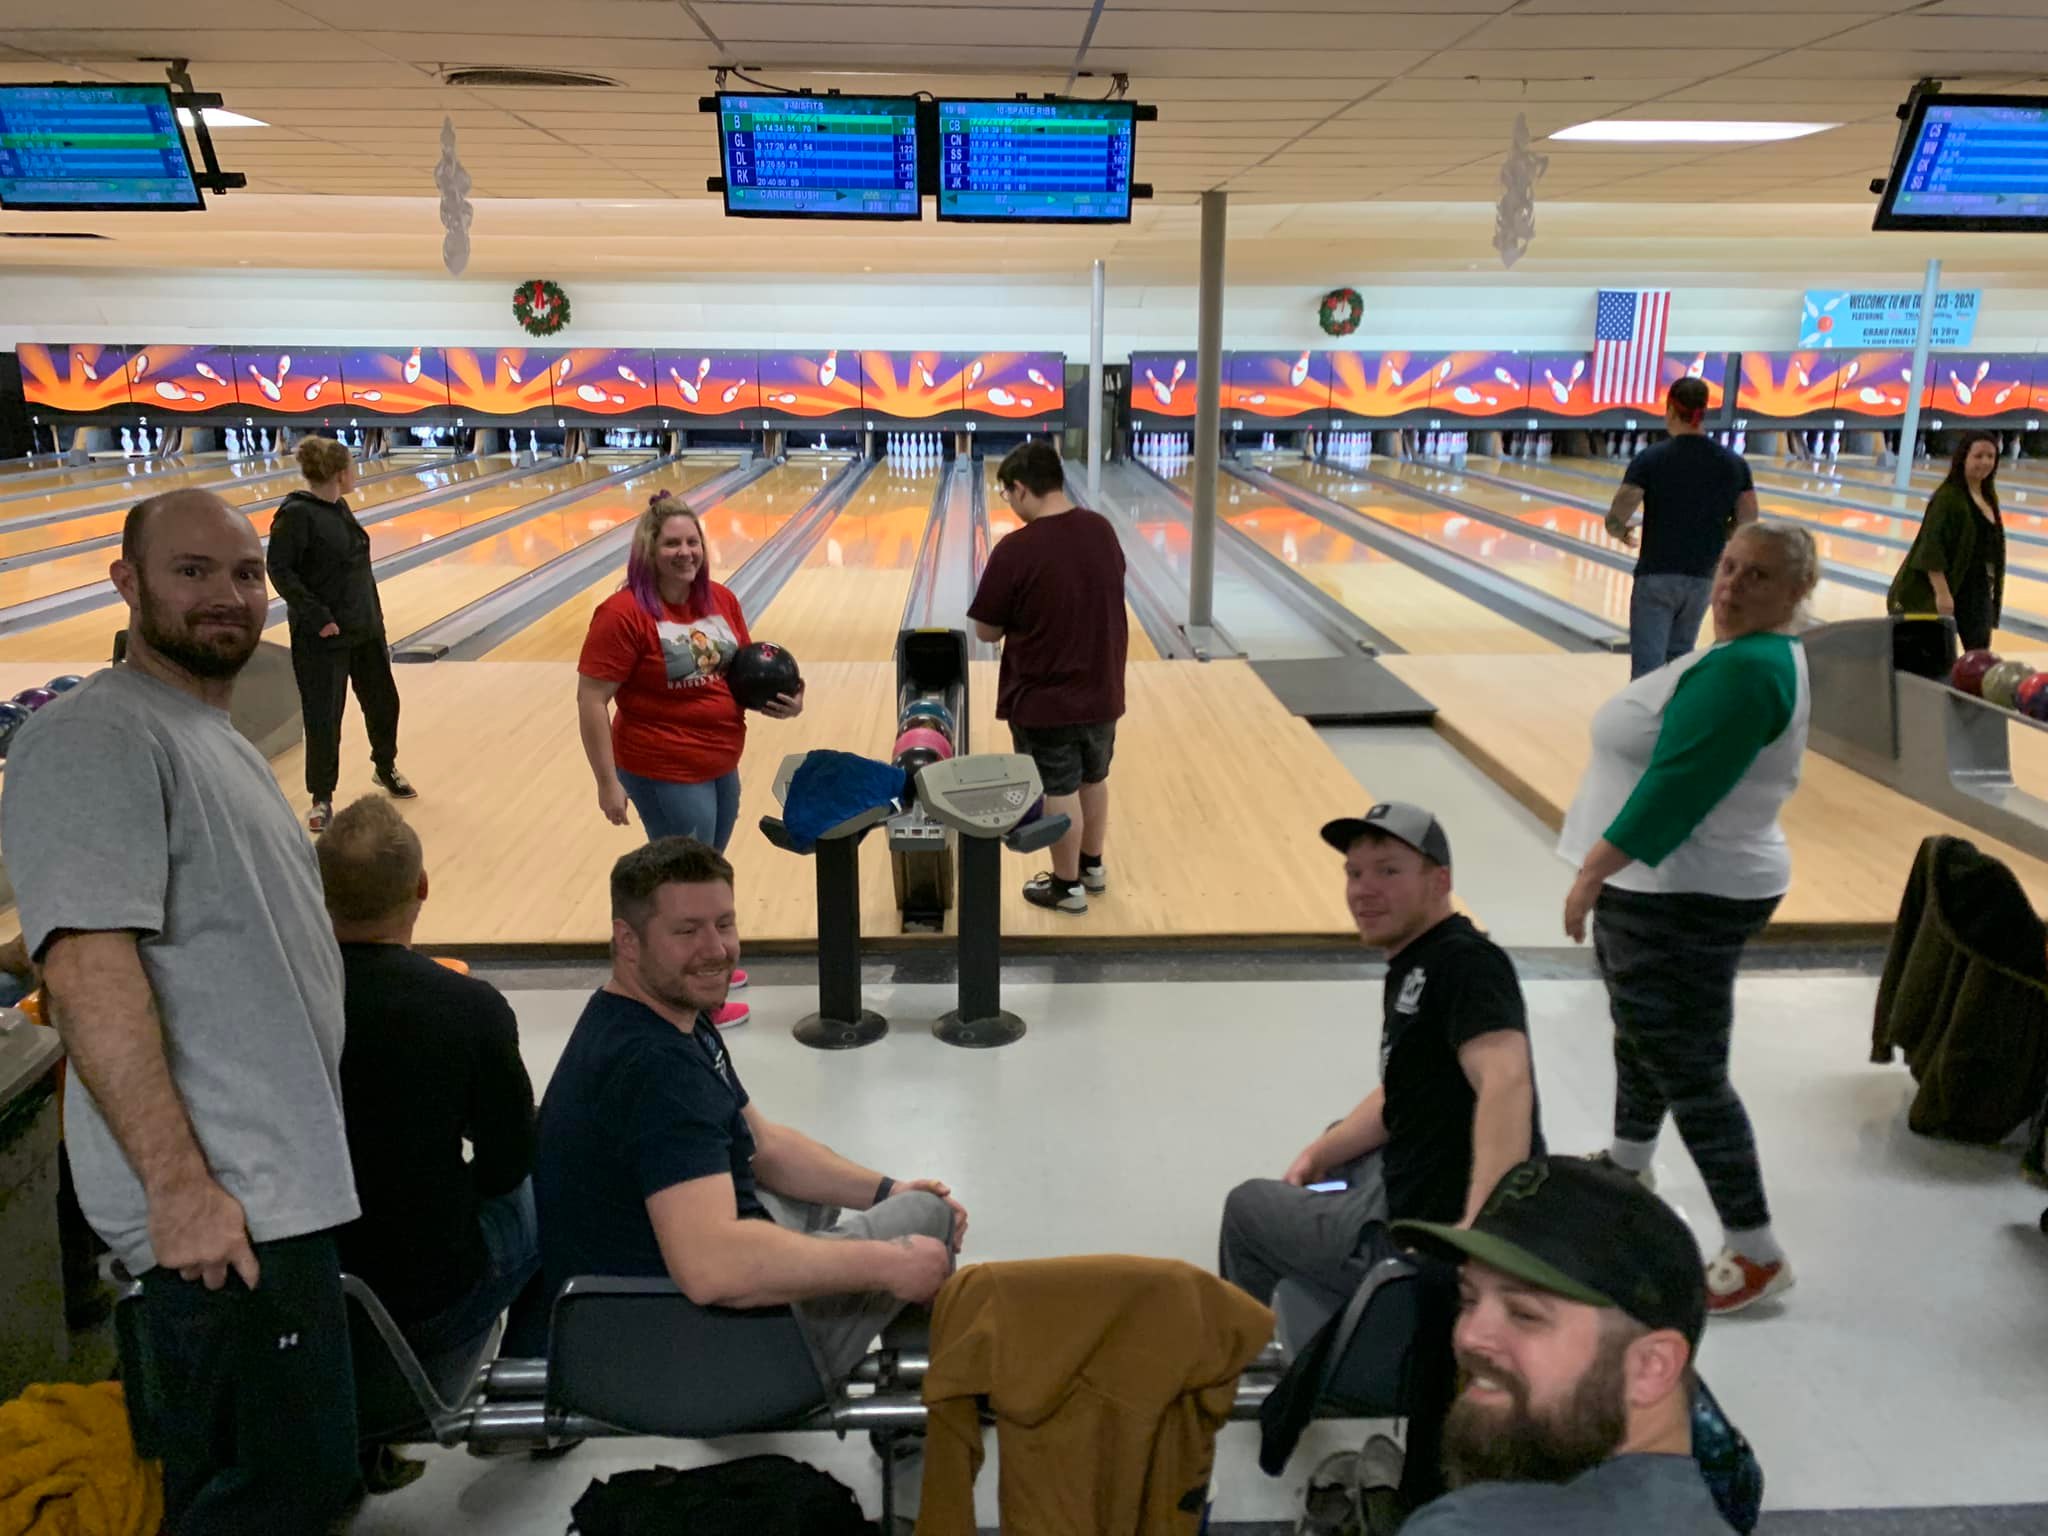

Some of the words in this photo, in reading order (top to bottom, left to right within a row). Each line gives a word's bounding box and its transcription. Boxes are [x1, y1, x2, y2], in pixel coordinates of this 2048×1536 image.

[734, 115, 740, 129] B
[949, 120, 960, 131] CB
[735, 133, 745, 147] GL
[950, 134, 962, 146] CN
[736, 151, 747, 165] DL
[951, 149, 962, 160] SS
[737, 169, 748, 184] RK
[952, 177, 962, 189] JK
[1850, 294, 1888, 309] WELCOME
[1954, 293, 1975, 309] 2024
[32, 416, 39, 424] 1
[139, 416, 147, 425] 2
[245, 417, 253, 426] 3
[350, 418, 357, 427] 4
[456, 418, 463, 427] 5
[558, 419, 565, 427] 6
[662, 419, 669, 428] 7
[762, 420, 770, 429] 8
[866, 421, 873, 430] 9
[1132, 420, 1142, 431] 11
[1736, 419, 1748, 430] 17
[965, 422, 976, 431] 10
